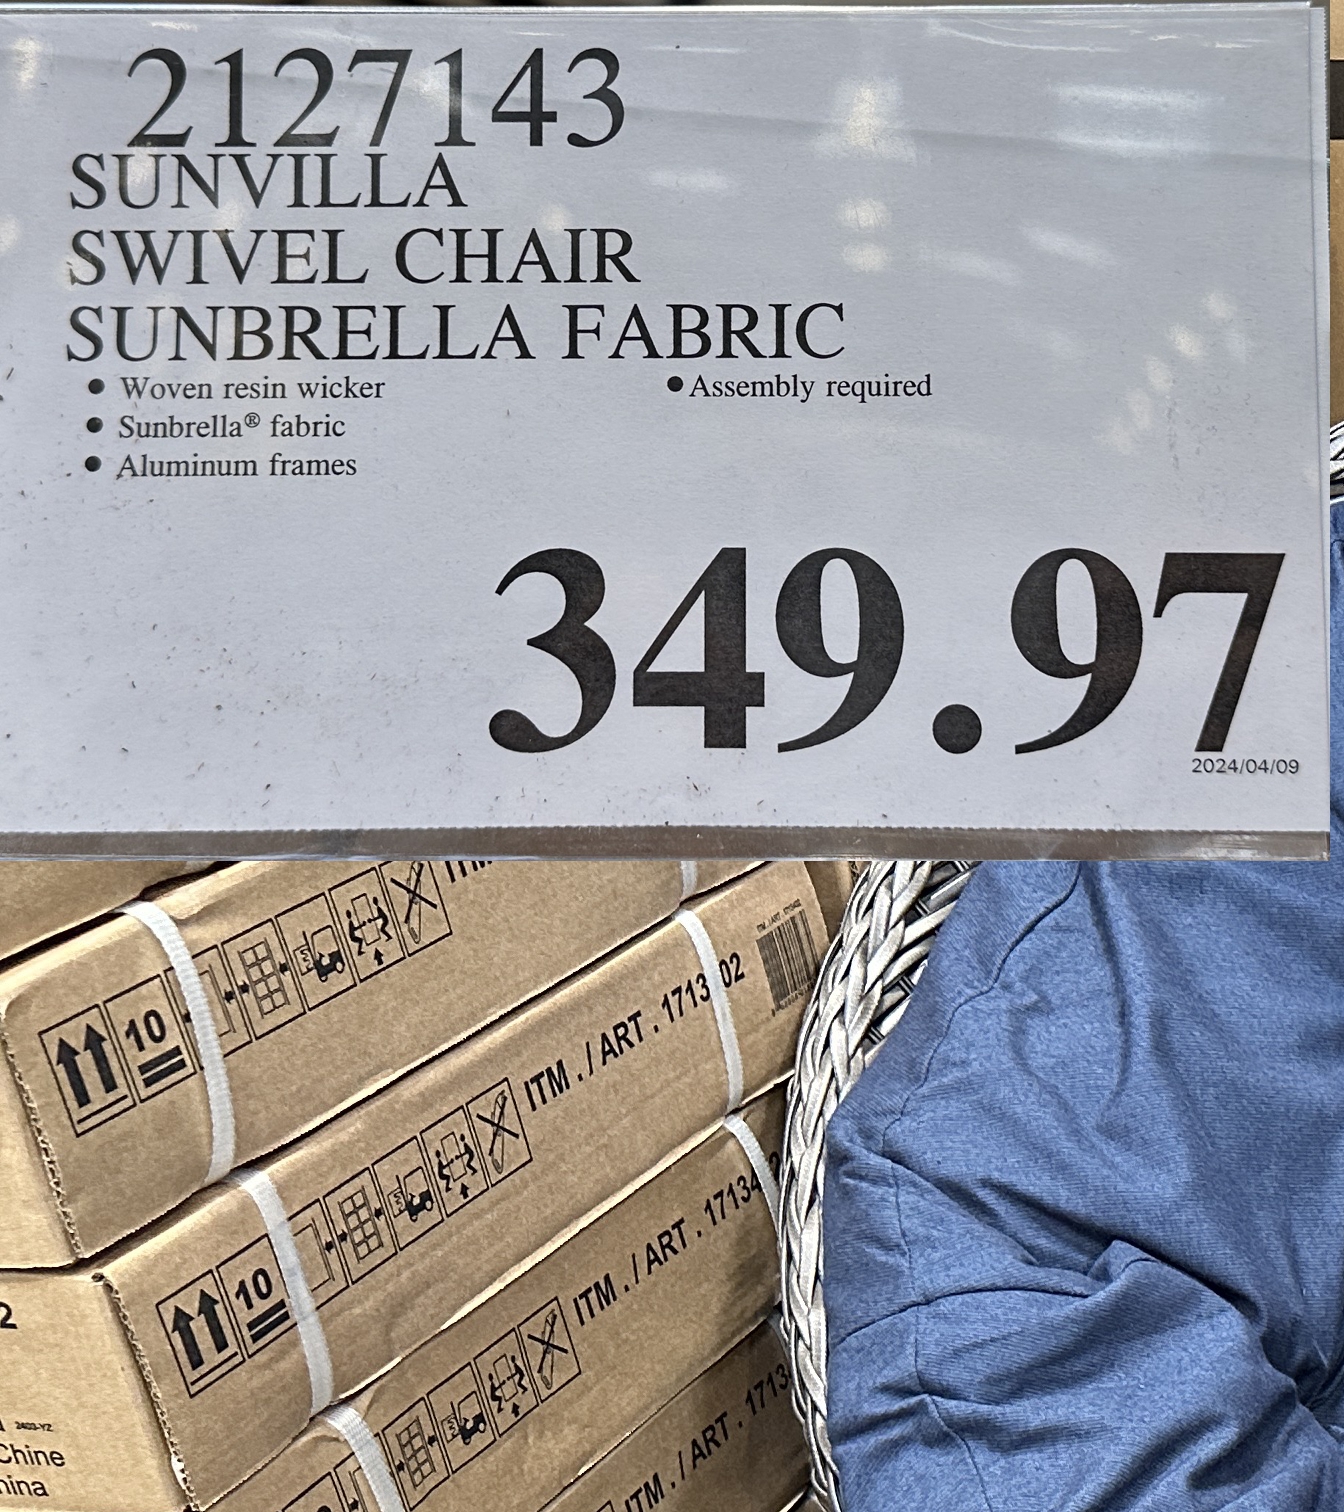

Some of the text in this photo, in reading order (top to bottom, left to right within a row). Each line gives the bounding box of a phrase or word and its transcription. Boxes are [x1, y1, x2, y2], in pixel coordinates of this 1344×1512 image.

[126, 47, 625, 149] 2127143
[69, 151, 469, 210] SUNVILLA
[66, 227, 642, 286] SWIVEL CHAIR
[66, 302, 845, 363] SUNBRELLA FABRIC
[119, 375, 386, 400] Woven resin wicker
[688, 373, 933, 404] Assembly required
[270, 413, 346, 438] fabric
[115, 452, 357, 481] Aluminum frames
[488, 547, 1287, 755] 349.97
[1191, 757, 1300, 775] 2024/04/09
[124, 1008, 167, 1053] 10
[234, 1267, 273, 1311] 10
